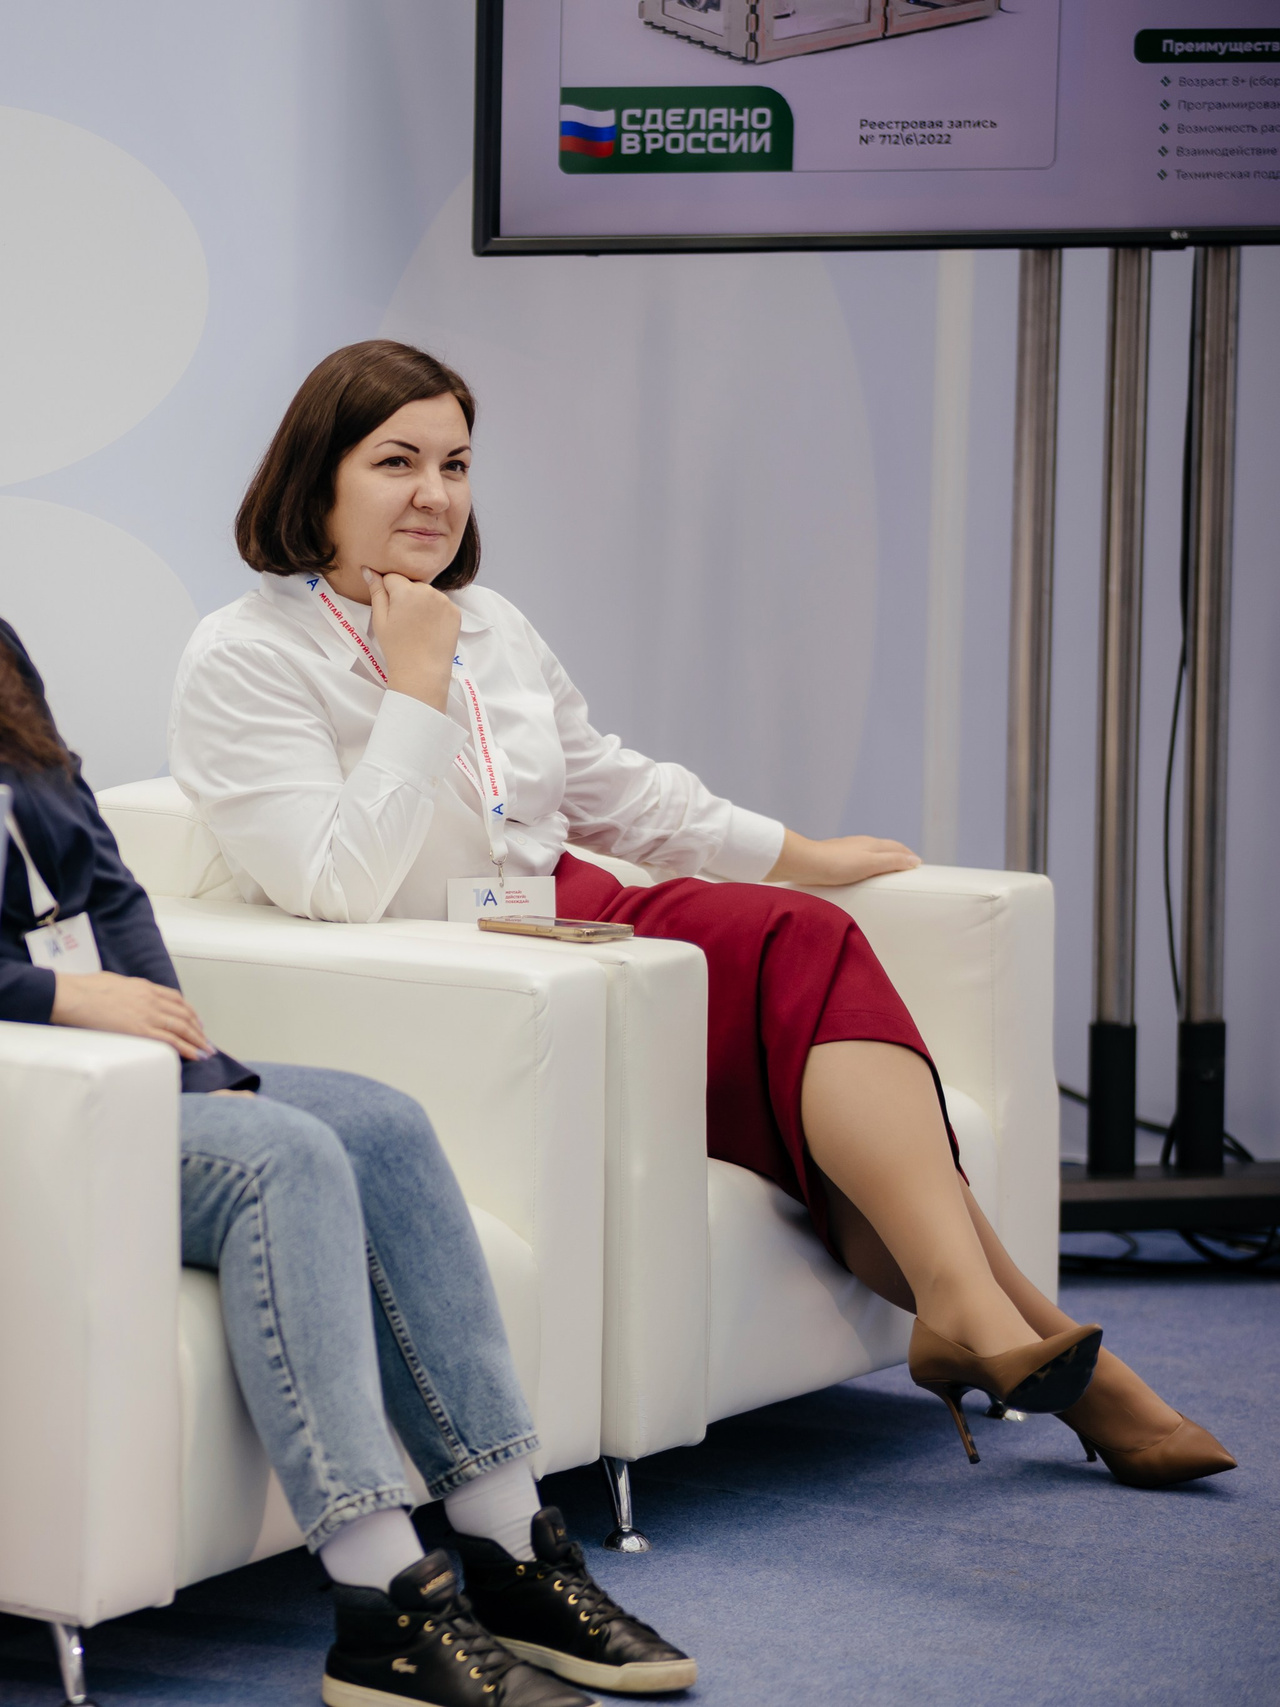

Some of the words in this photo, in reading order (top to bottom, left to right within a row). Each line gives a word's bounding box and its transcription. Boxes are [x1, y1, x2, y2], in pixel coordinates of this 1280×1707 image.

[621, 107, 771, 132] СДЕЛАНО
[859, 118, 943, 131] Реестровая
[947, 119, 998, 129] запись
[1177, 123, 1257, 134] Возможность
[1176, 146, 1278, 158] Взаимодействие
[1175, 168, 1250, 180] Техническая
[319, 592, 344, 620] МЕЧТАЙ!
[340, 619, 371, 655] ДЕЙСТВУЙ!
[368, 655, 388, 683] ПОБЕЖ
[477, 724, 495, 764] ДЕЙСТВУЙ!
[486, 764, 500, 797] МЕЧТАЙ!
